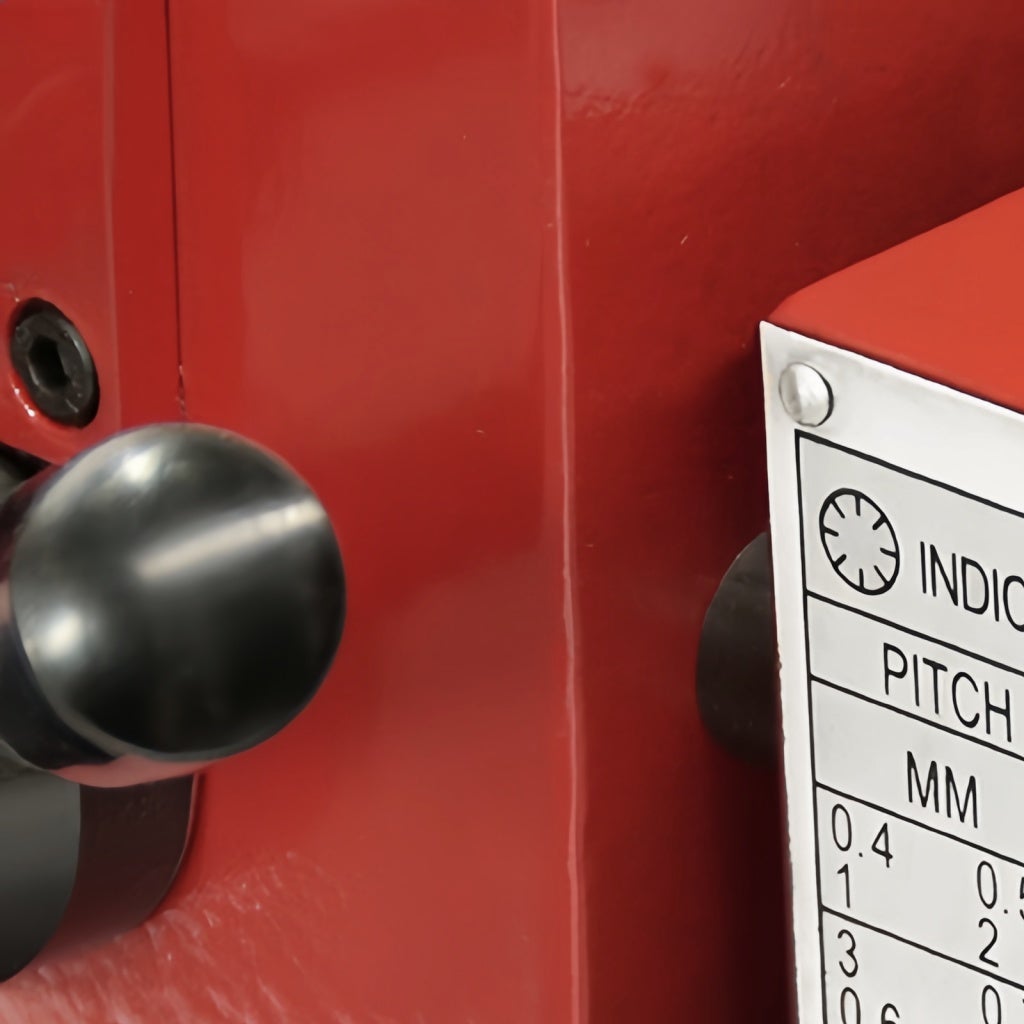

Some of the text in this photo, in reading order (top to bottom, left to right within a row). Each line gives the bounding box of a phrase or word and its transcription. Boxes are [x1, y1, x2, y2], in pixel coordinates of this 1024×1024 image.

[882, 642, 1013, 743] PITCH
[905, 750, 980, 829] MM
[830, 803, 894, 868] 0.4
[835, 863, 1000, 967] 1 2
[836, 929, 860, 978] 3
